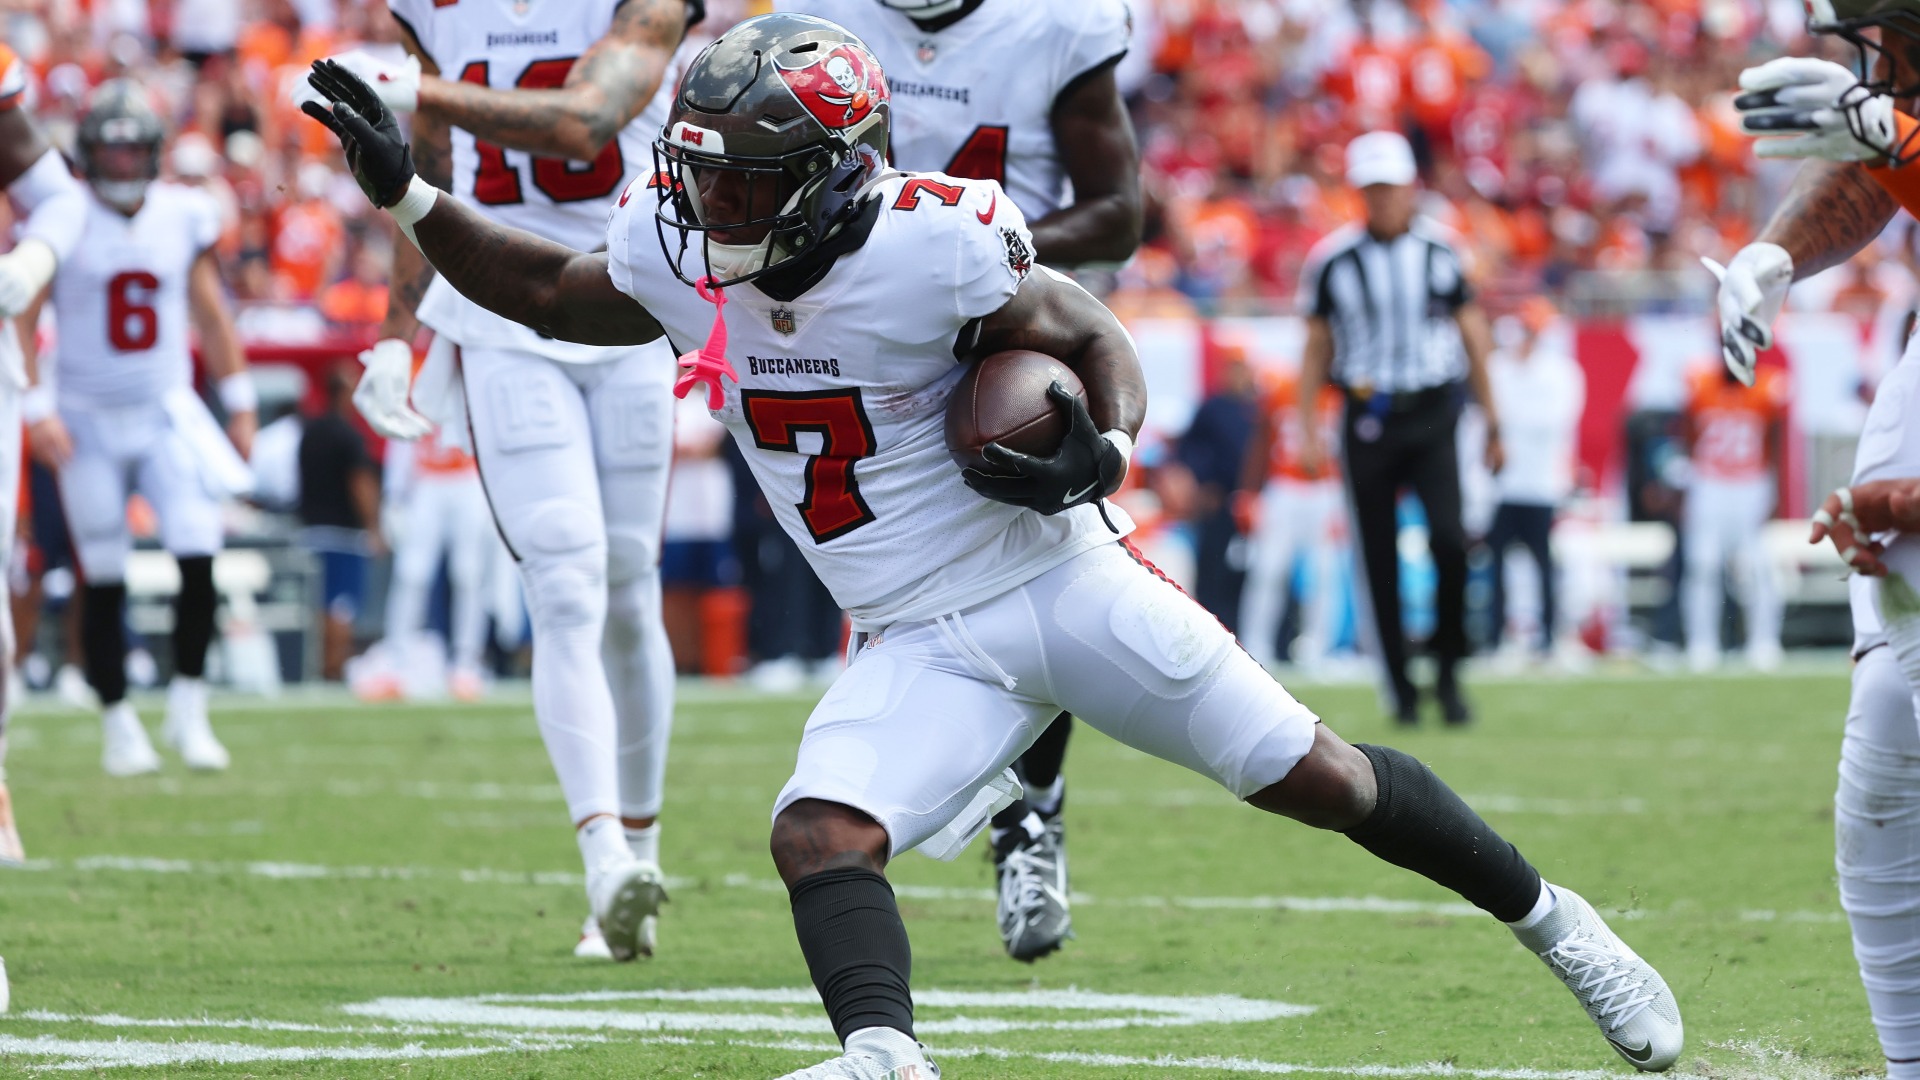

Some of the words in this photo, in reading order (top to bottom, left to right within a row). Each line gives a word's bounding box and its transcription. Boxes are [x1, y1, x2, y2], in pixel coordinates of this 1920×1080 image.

[891, 178, 966, 211] 7
[107, 269, 159, 353] 6
[746, 355, 840, 378] BUCCANEERS
[740, 386, 878, 545] 7
